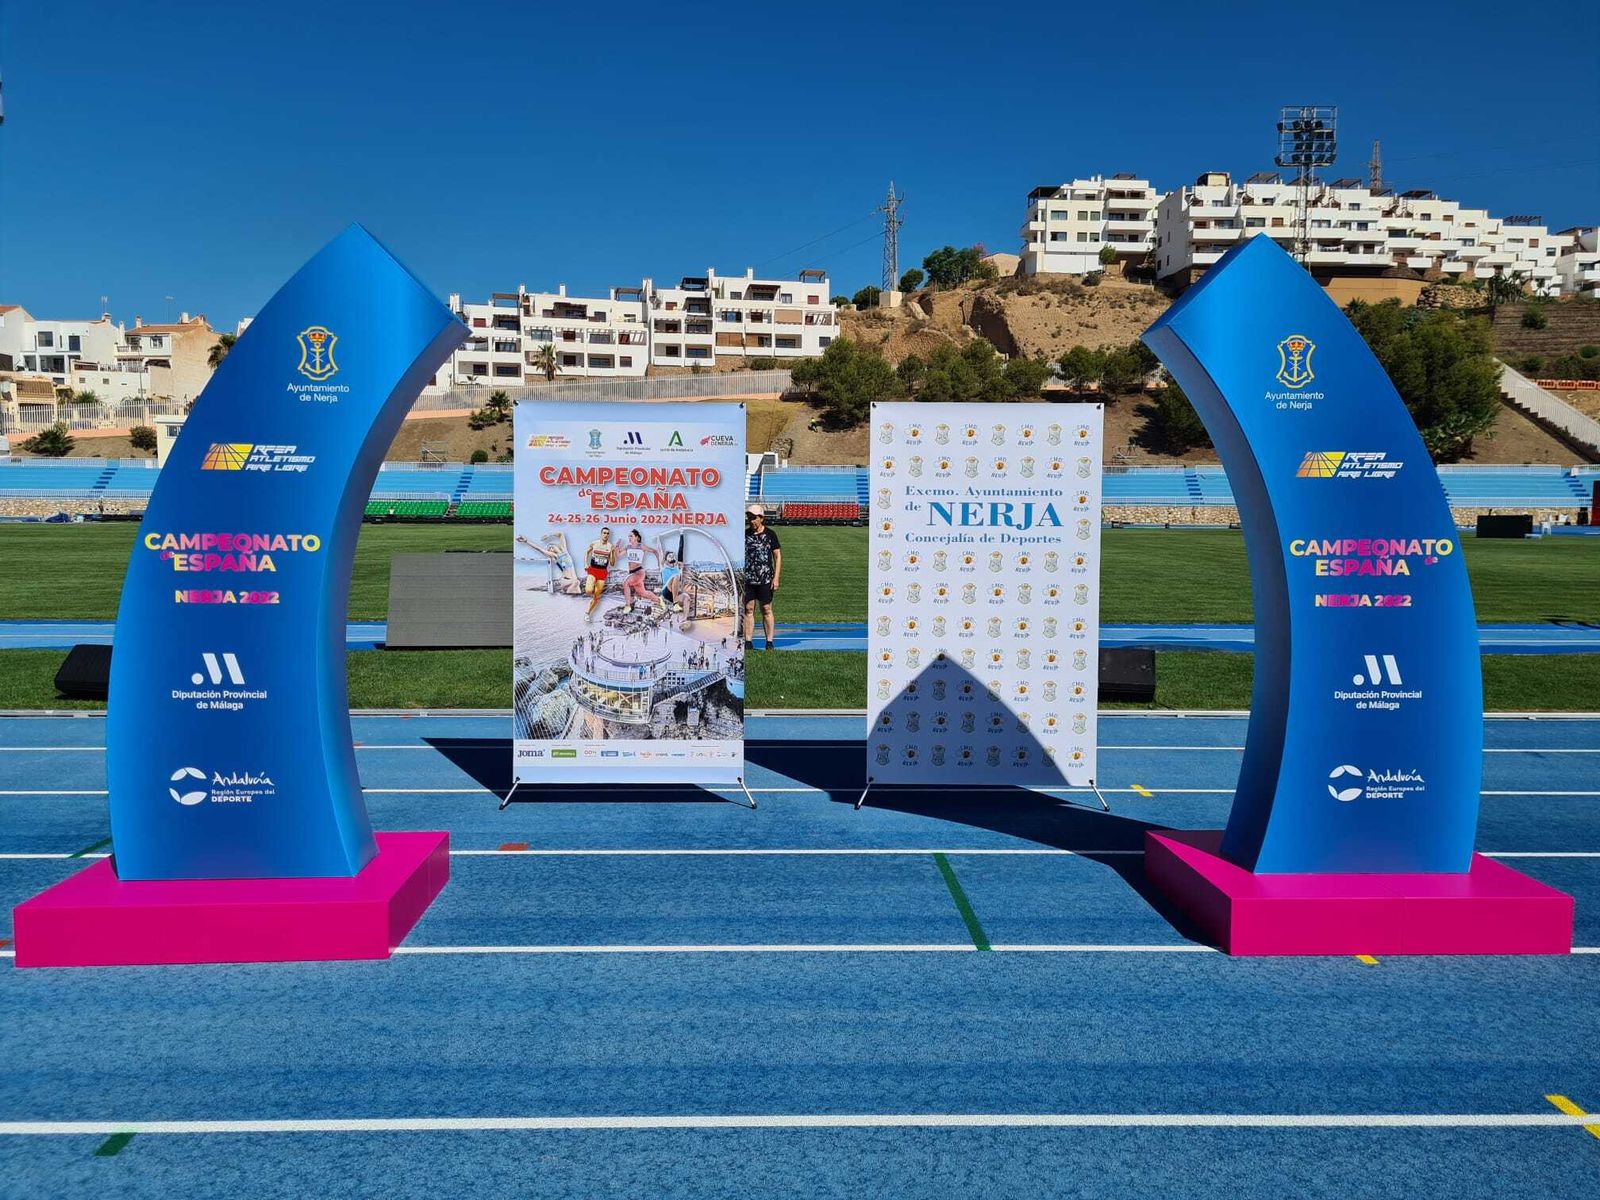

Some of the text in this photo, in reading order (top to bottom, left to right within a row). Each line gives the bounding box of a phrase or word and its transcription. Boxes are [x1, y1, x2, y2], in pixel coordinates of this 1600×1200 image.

[286, 383, 350, 393] Ayuntamiento
[300, 393, 338, 404] de Nerja
[1265, 392, 1324, 401] Ayuntamiento
[1276, 401, 1312, 410] de Nerja
[253, 445, 296, 454] RFEA
[1344, 452, 1386, 462] RFEA
[274, 464, 308, 472] LIBRE
[539, 466, 720, 486] CAMPEONATO
[905, 486, 1063, 498] Excmo. Ayuntamiento
[578, 488, 687, 509] de ESPAÑA
[548, 513, 727, 525] 24-25-26 Junio 2022 NERJA
[905, 501, 1064, 530] de NERJA
[144, 533, 320, 552] CAMPEONATO
[905, 532, 1062, 545] Concejalía de Deportes
[1290, 539, 1453, 556] CAMPEONATO
[174, 550, 276, 572] ESPAÑA
[1315, 554, 1410, 576] ESPAÑA
[175, 590, 280, 604] NERJA 2022
[1315, 594, 1412, 607] NERJA 2022
[172, 690, 267, 700] Diputación Provincial
[1334, 690, 1422, 700] Diputación Provincial
[196, 701, 244, 710] de Málaga
[1369, 701, 1400, 710] Málaga
[212, 771, 275, 786] Andalucía
[1367, 769, 1425, 783] Andalucía
